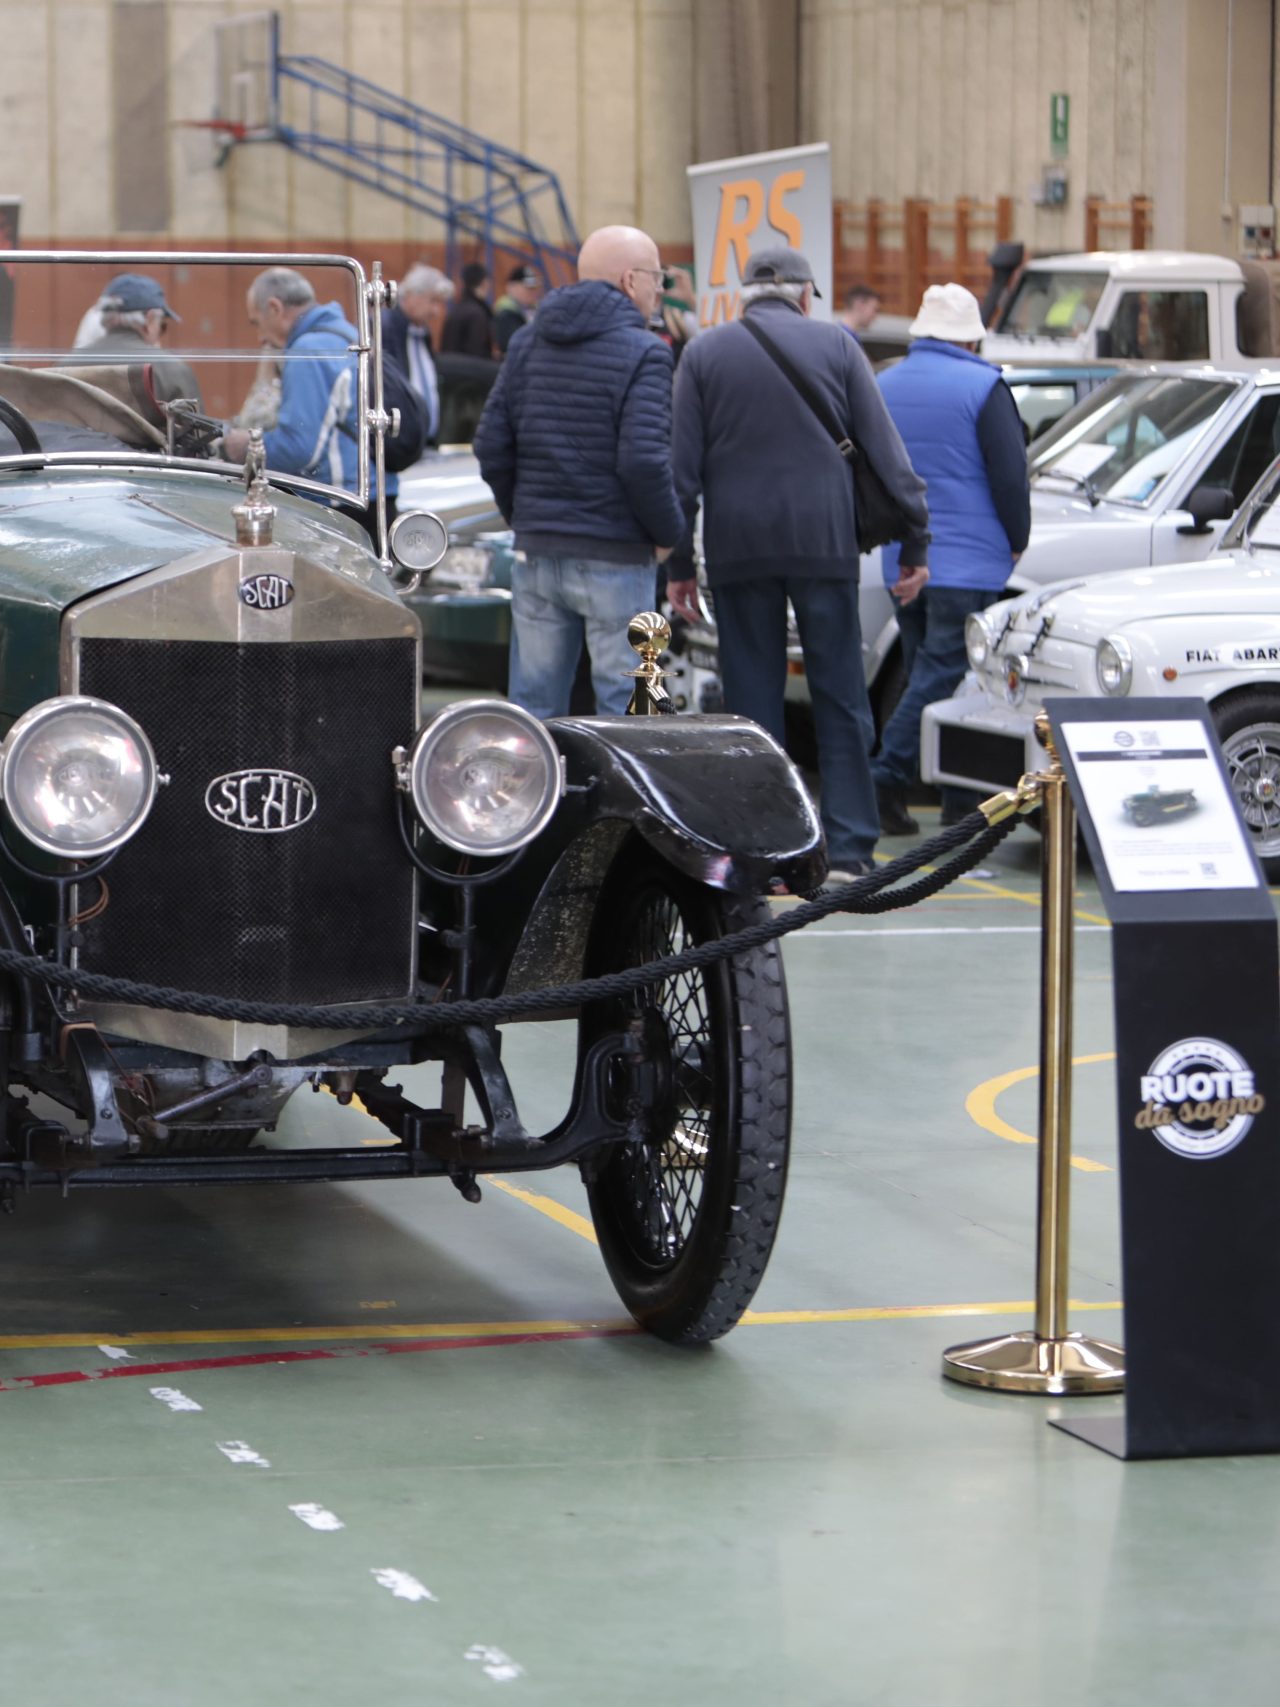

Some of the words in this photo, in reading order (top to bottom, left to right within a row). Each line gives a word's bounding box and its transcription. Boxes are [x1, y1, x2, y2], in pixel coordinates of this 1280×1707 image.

[710, 169, 806, 287] RS
[242, 576, 289, 608] SCAT
[1186, 650, 1219, 662] FIAT
[1233, 647, 1280, 661] ABAR
[214, 775, 310, 828] SCAT
[1140, 1070, 1255, 1103] RUOTE
[1134, 1100, 1175, 1129] da
[1178, 1093, 1265, 1130] sogno
